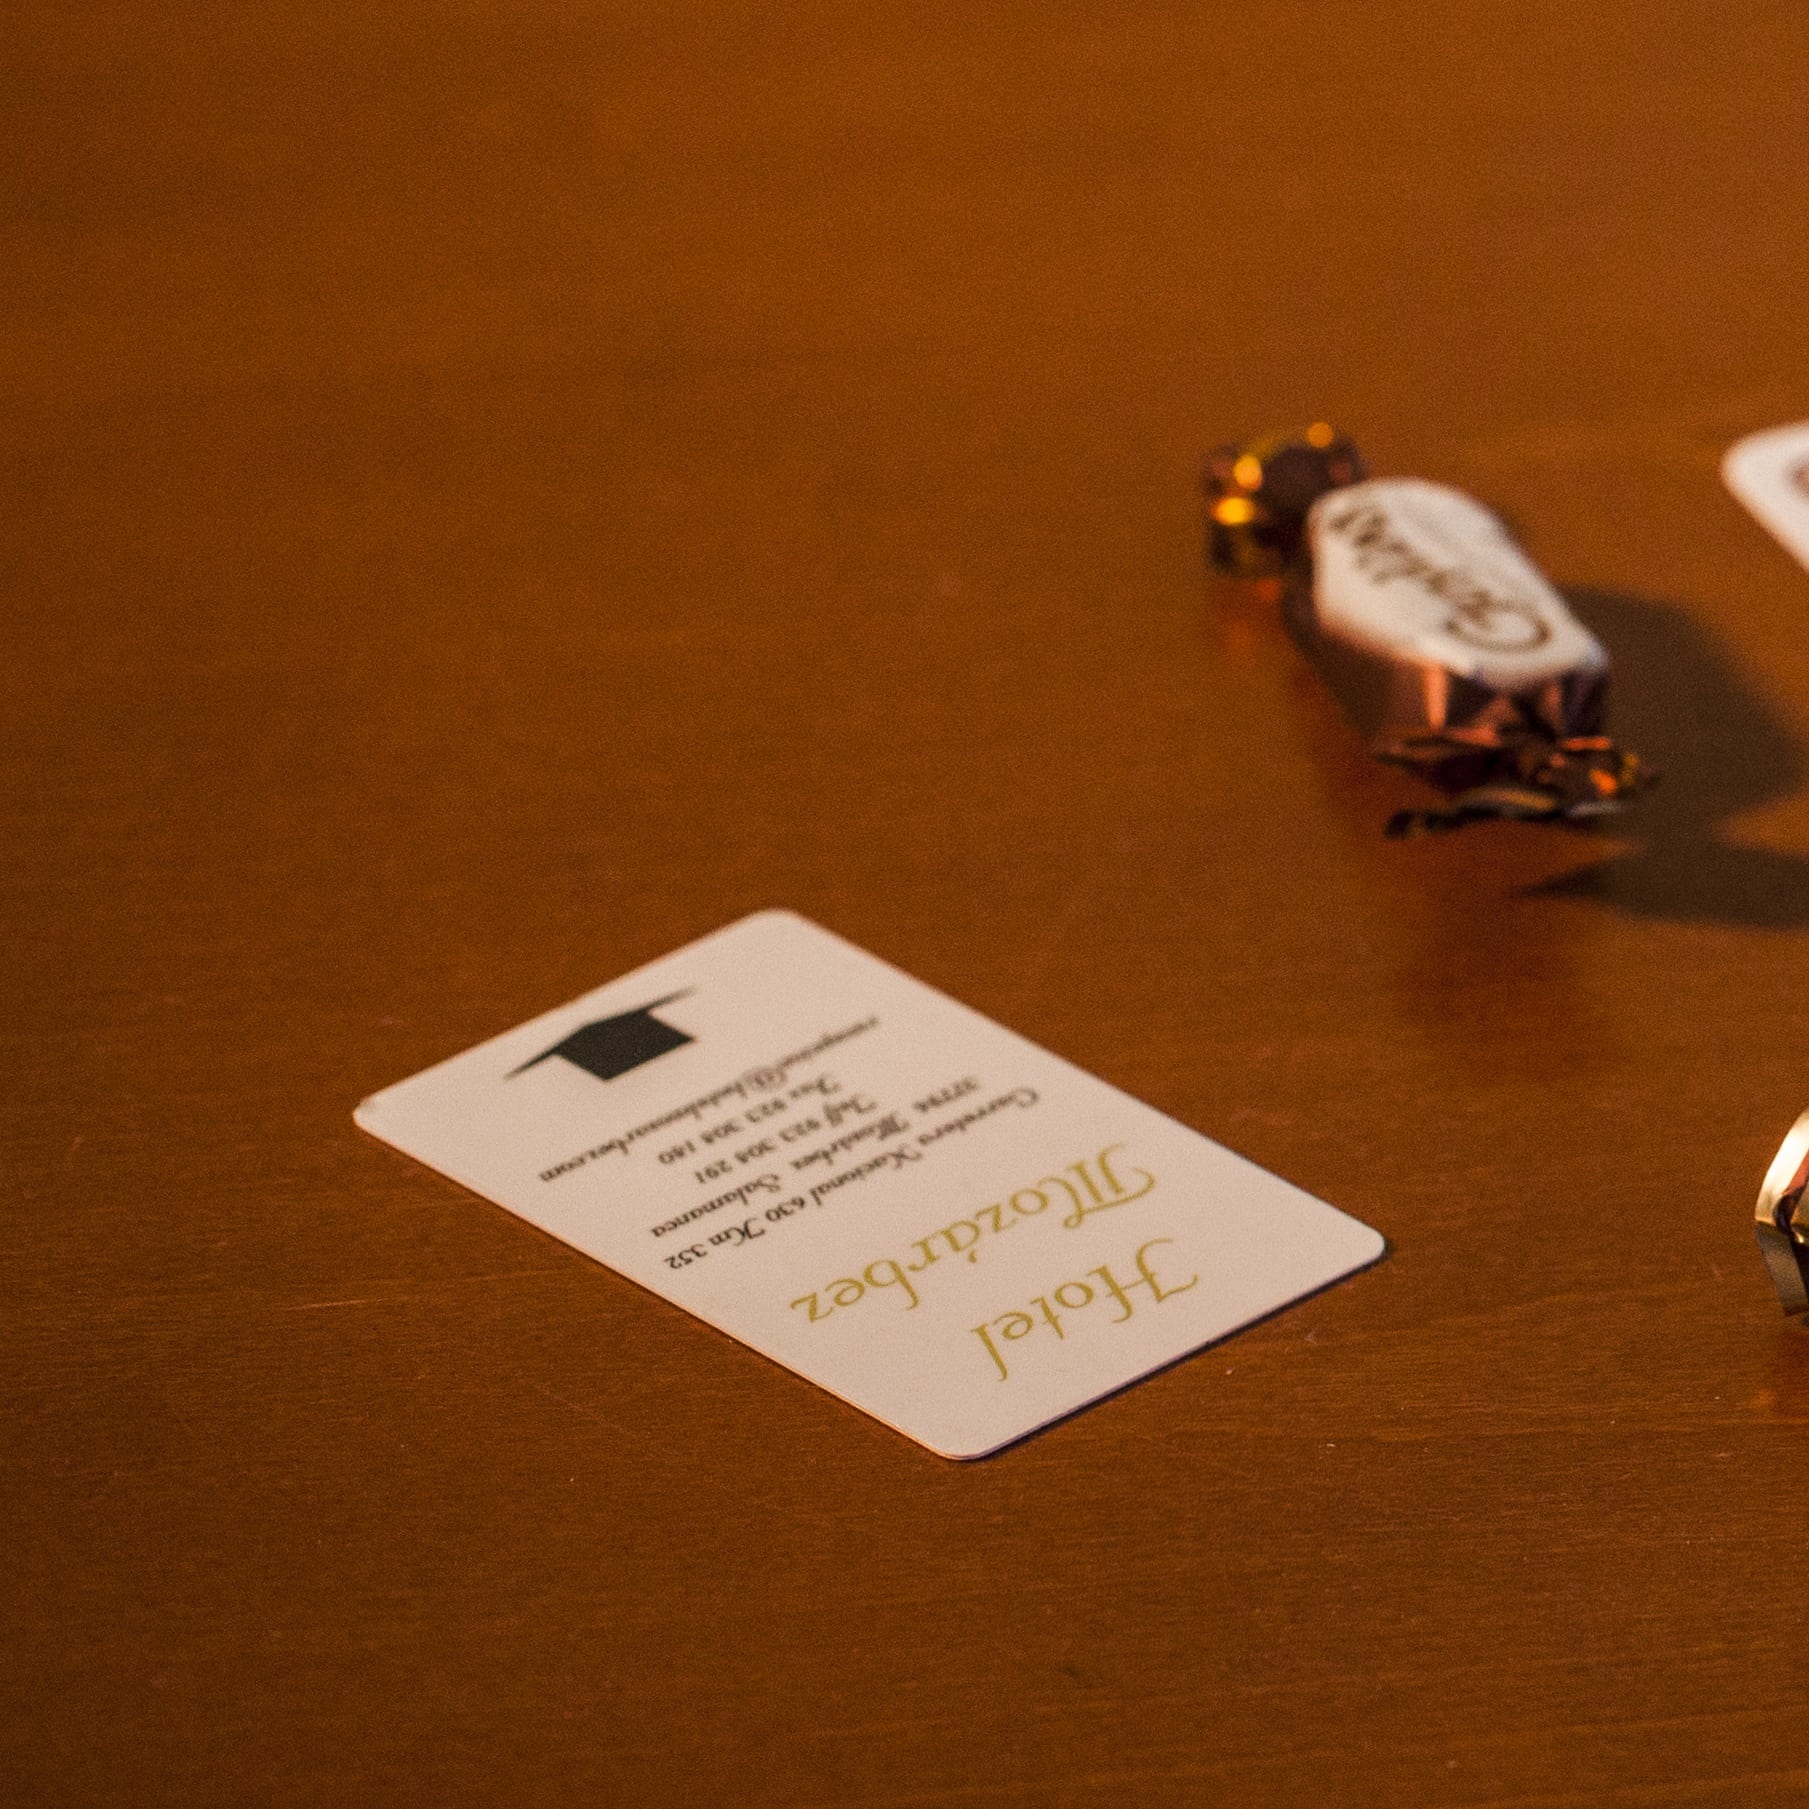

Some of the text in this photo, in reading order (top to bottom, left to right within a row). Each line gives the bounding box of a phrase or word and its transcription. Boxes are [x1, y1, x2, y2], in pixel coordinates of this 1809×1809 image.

[694, 1158, 734, 1186] 291
[809, 1142, 924, 1208] Nacional
[650, 1172, 783, 1242] Salamanca
[765, 1195, 806, 1223] 630
[708, 1216, 768, 1248] Km
[790, 1142, 1156, 1326] Mozárbez
[664, 1244, 709, 1271] 352
[970, 1237, 1199, 1383] Hotel
